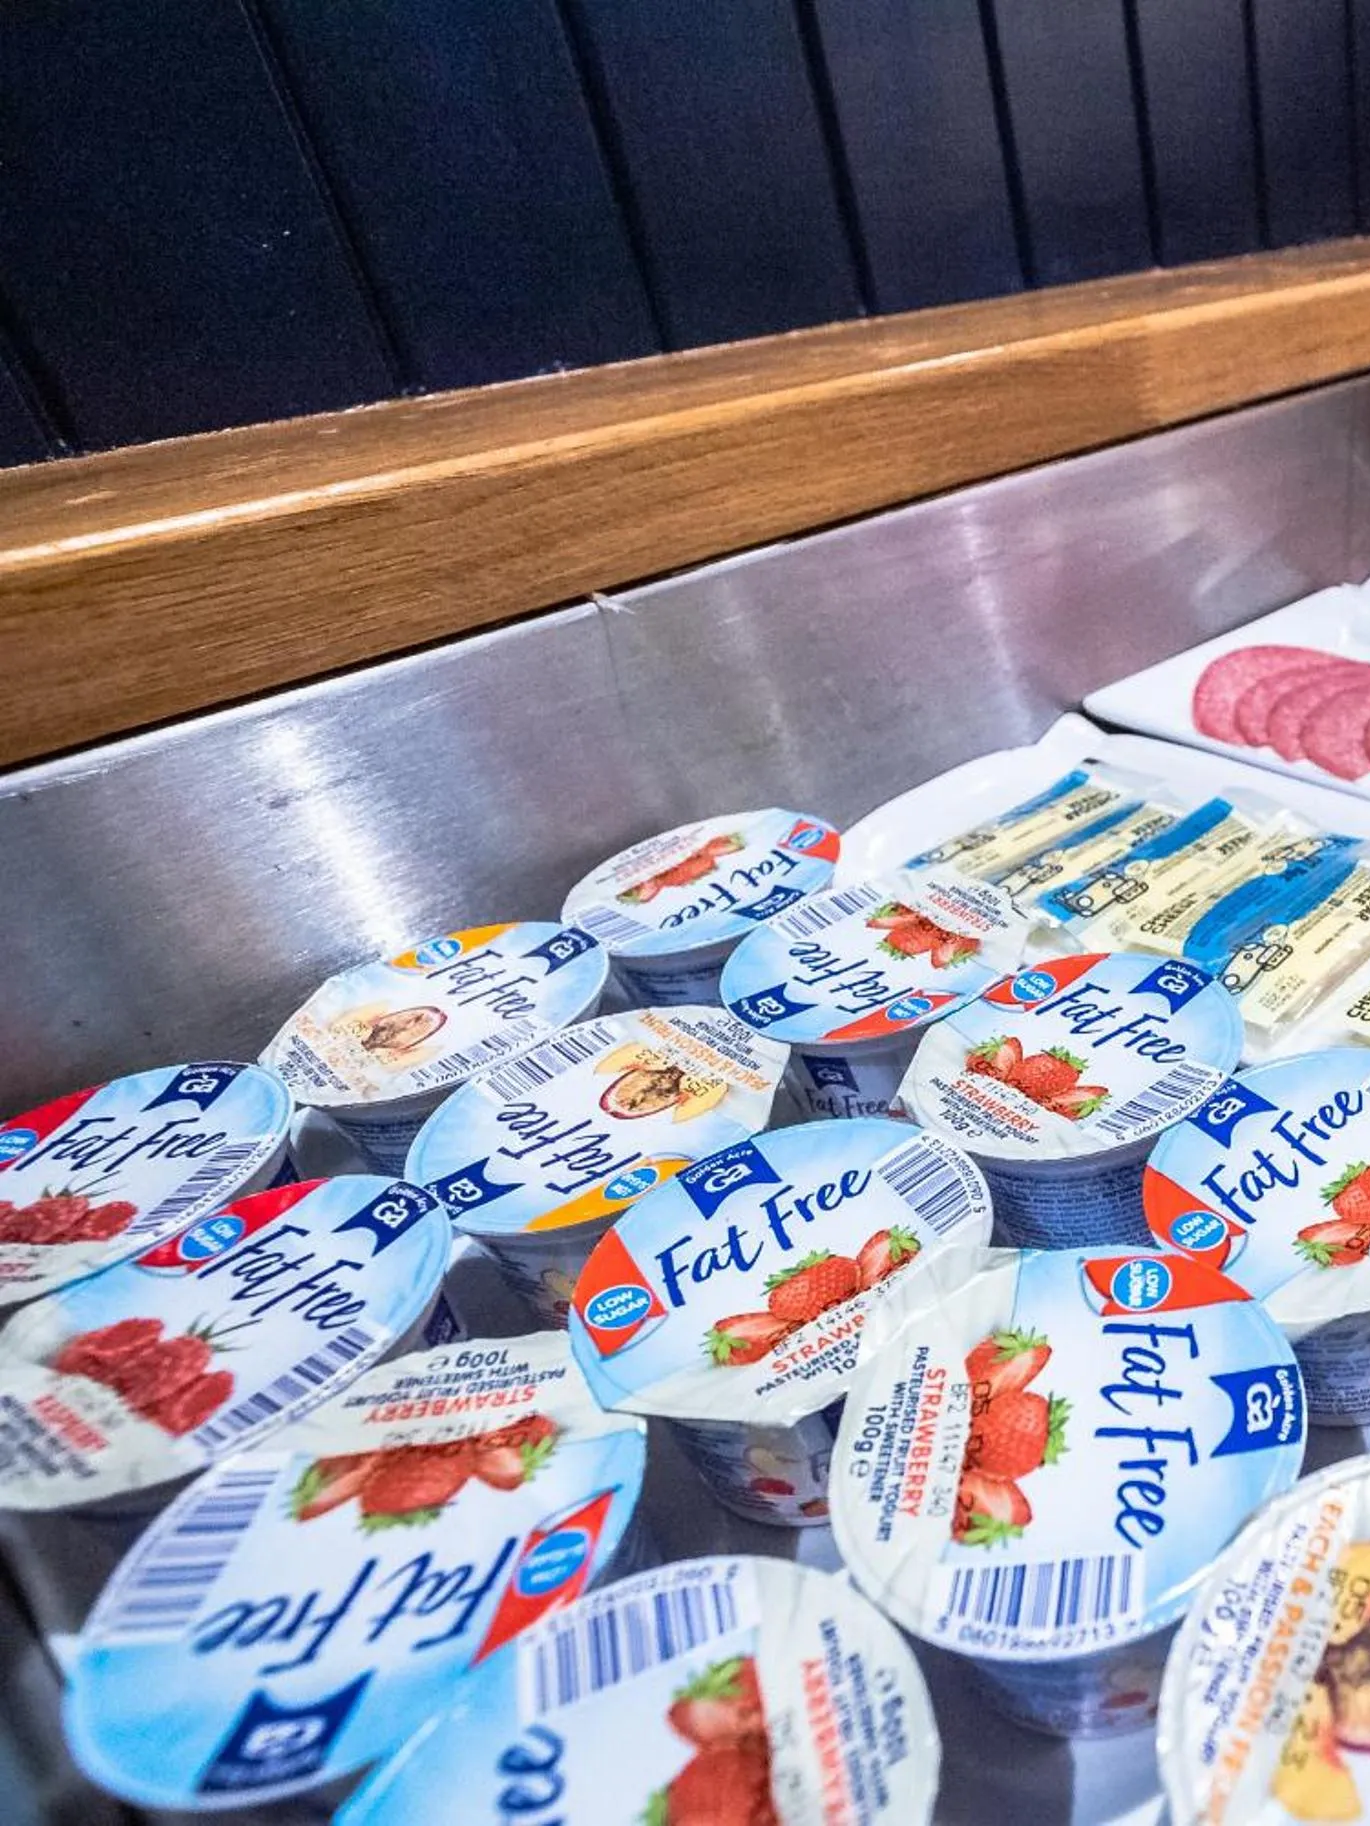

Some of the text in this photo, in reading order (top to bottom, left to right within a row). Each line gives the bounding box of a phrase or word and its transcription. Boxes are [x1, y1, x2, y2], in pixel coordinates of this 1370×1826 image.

[730, 849, 801, 887] Fat
[659, 882, 742, 930] Free
[426, 949, 505, 995] Fat
[788, 941, 869, 986] Free
[457, 976, 539, 1020] Free
[829, 971, 914, 1015] Fat
[1034, 982, 1188, 1064] Fat Free
[496, 1100, 593, 1161] Free
[841, 1093, 891, 1119] Free
[938, 1109, 971, 1132] 100g
[950, 1079, 1041, 1134] STRAWBERRY
[14, 1117, 227, 1173] Fat Free
[540, 1134, 643, 1195] Fat
[1201, 1149, 1300, 1225] Fat
[1270, 1088, 1364, 1167] Free
[198, 1224, 311, 1301] Fat
[655, 1169, 873, 1308] Fat Free
[250, 1263, 369, 1330] Free
[596, 1290, 634, 1312] LOW
[1144, 1266, 1159, 1301] LOW
[593, 1297, 649, 1326] SUGAR
[394, 1362, 530, 1390] WITH SWEETENER
[454, 1350, 510, 1369] 100g
[466, 1366, 567, 1394] PASTEURISED
[755, 1339, 852, 1396] PASTEURISED
[361, 1383, 537, 1425] STRAWBERRY
[900, 1345, 930, 1435] PASTEURISED
[853, 1403, 888, 1454] 100g
[869, 1380, 908, 1503] WITH SWEETENER
[898, 1366, 948, 1518] STRAWBERRY
[1095, 1321, 1201, 1551] Fat Free
[192, 1556, 378, 1677] Free
[366, 1536, 518, 1655] Fat
[1238, 1603, 1305, 1731] PASSION
[496, 1723, 567, 1826] ee
